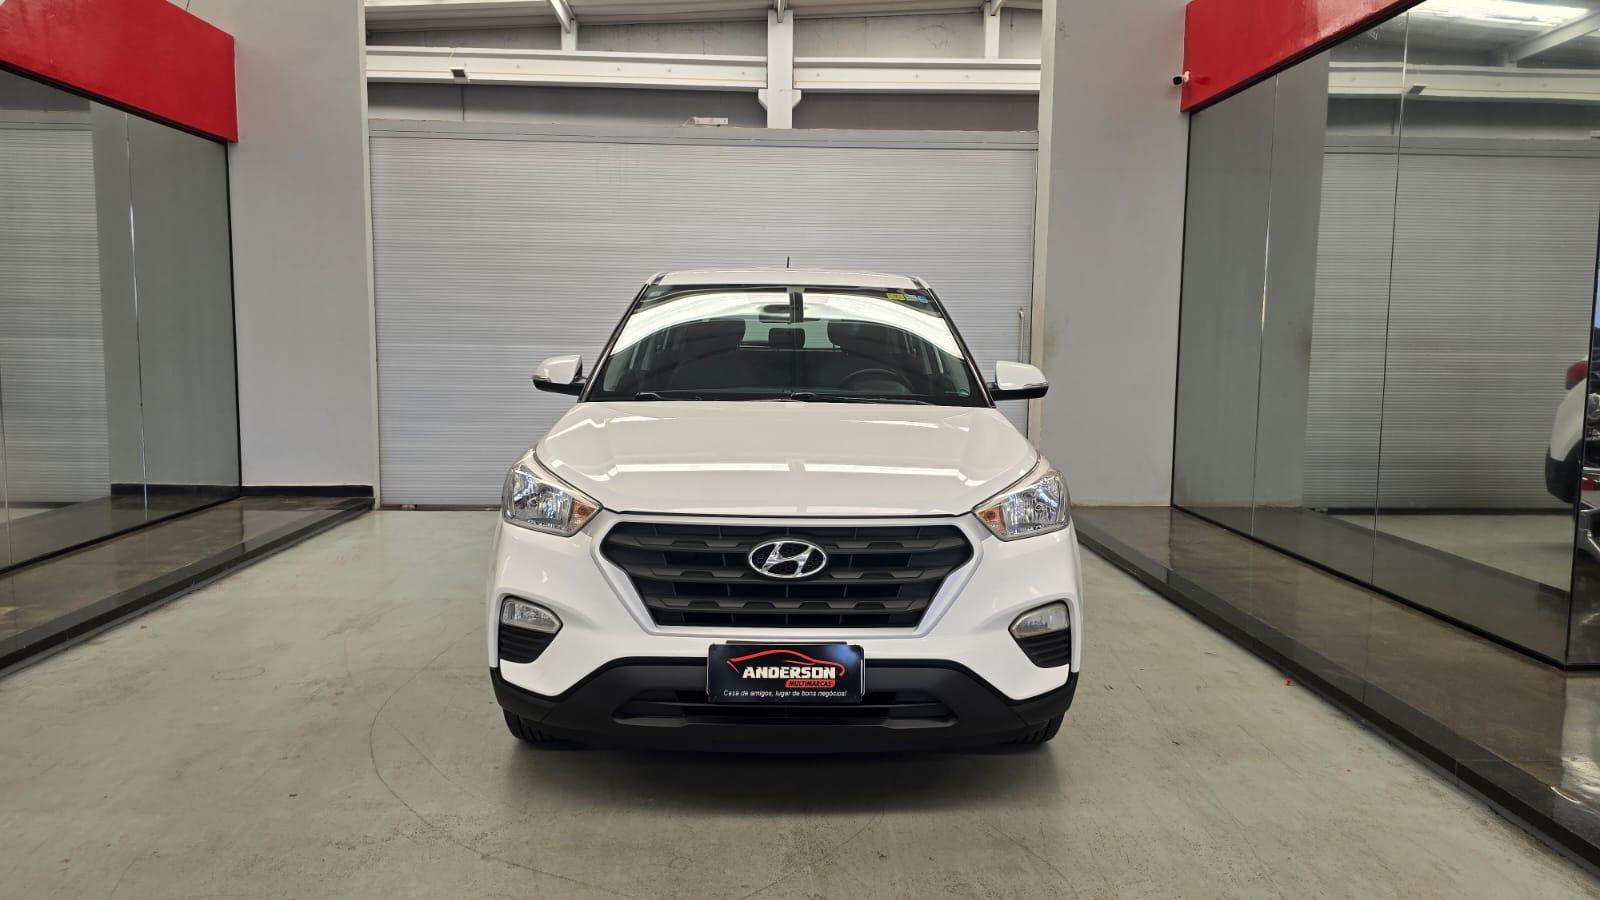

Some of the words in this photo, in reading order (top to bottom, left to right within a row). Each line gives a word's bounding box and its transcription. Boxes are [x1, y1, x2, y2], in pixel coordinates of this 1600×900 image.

[742, 666, 836, 679] ANDERSON
[775, 690, 791, 698] lugar
[817, 690, 847, 698] negócios!
